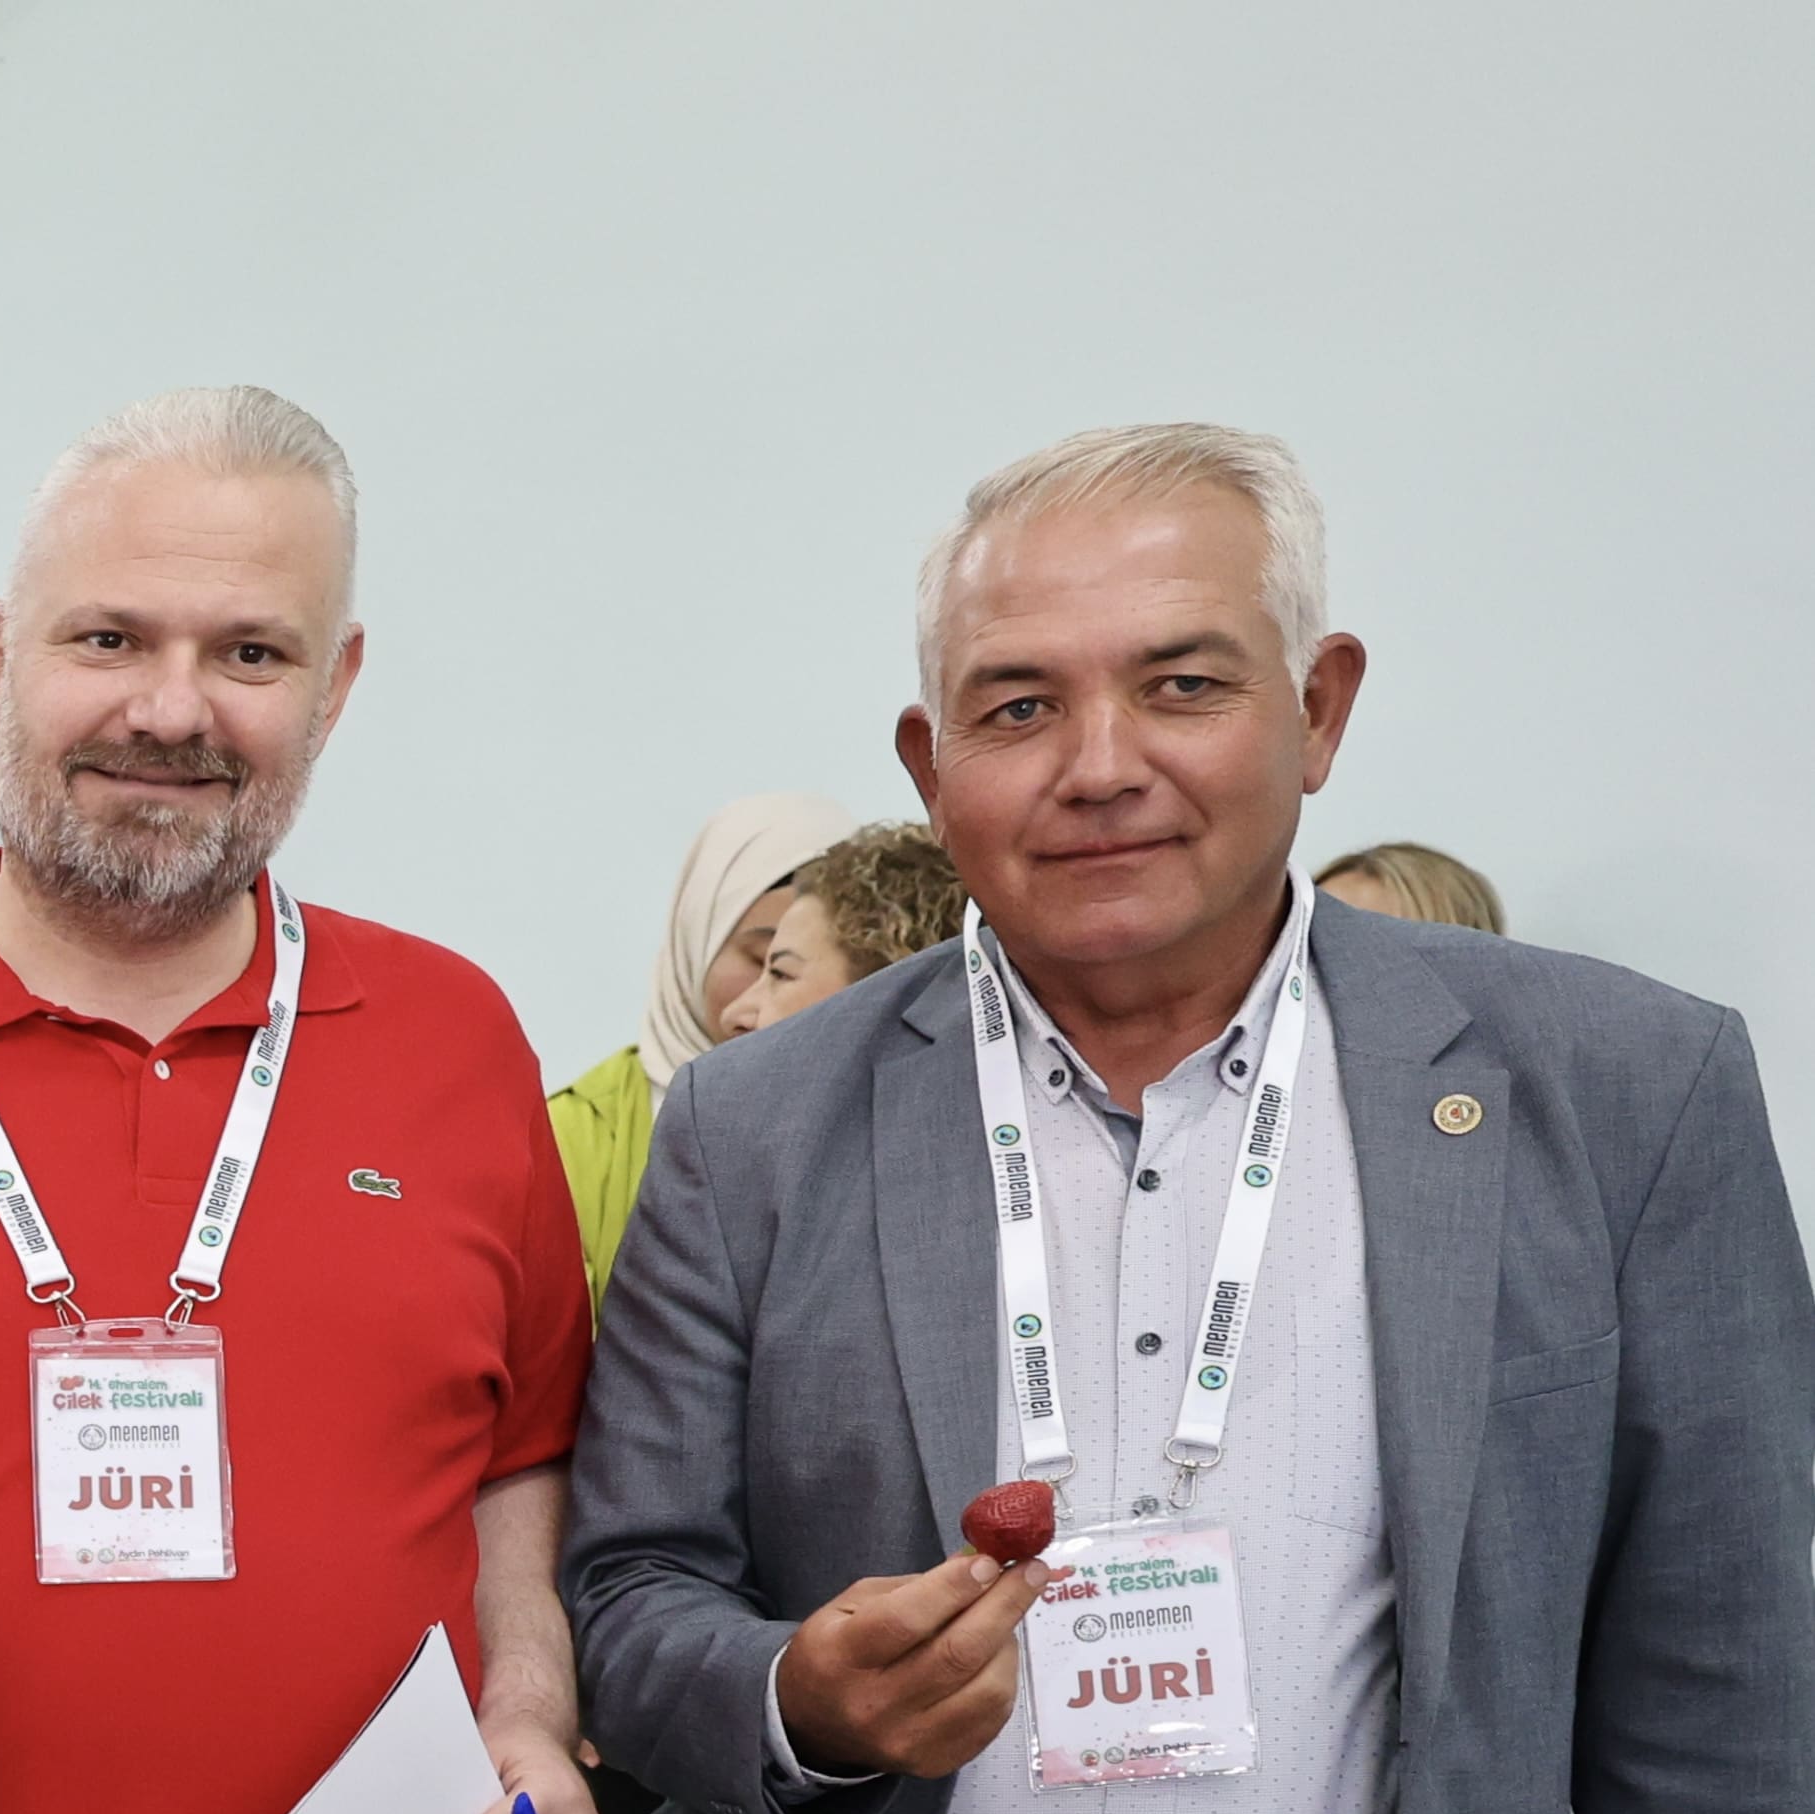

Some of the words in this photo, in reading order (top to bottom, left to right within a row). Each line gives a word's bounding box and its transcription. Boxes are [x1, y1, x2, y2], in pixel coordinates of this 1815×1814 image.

[977, 974, 1007, 1043] menemen
[1248, 1083, 1284, 1158] menemen
[204, 1155, 242, 1221] menemen
[1004, 1151, 1034, 1221] menemen
[5, 1193, 49, 1254] menemen
[1202, 1280, 1242, 1358] menemen
[52, 1392, 103, 1410] Çilek
[109, 1389, 204, 1410] festivali
[1024, 1345, 1054, 1420] menemen
[109, 1424, 180, 1442] menemen
[67, 1464, 194, 1511] JÜRİ
[1040, 1581, 1101, 1605] Çilek
[1106, 1565, 1220, 1597] festivali
[1109, 1604, 1193, 1631] menemen
[1066, 1647, 1214, 1709] JÜRİ
